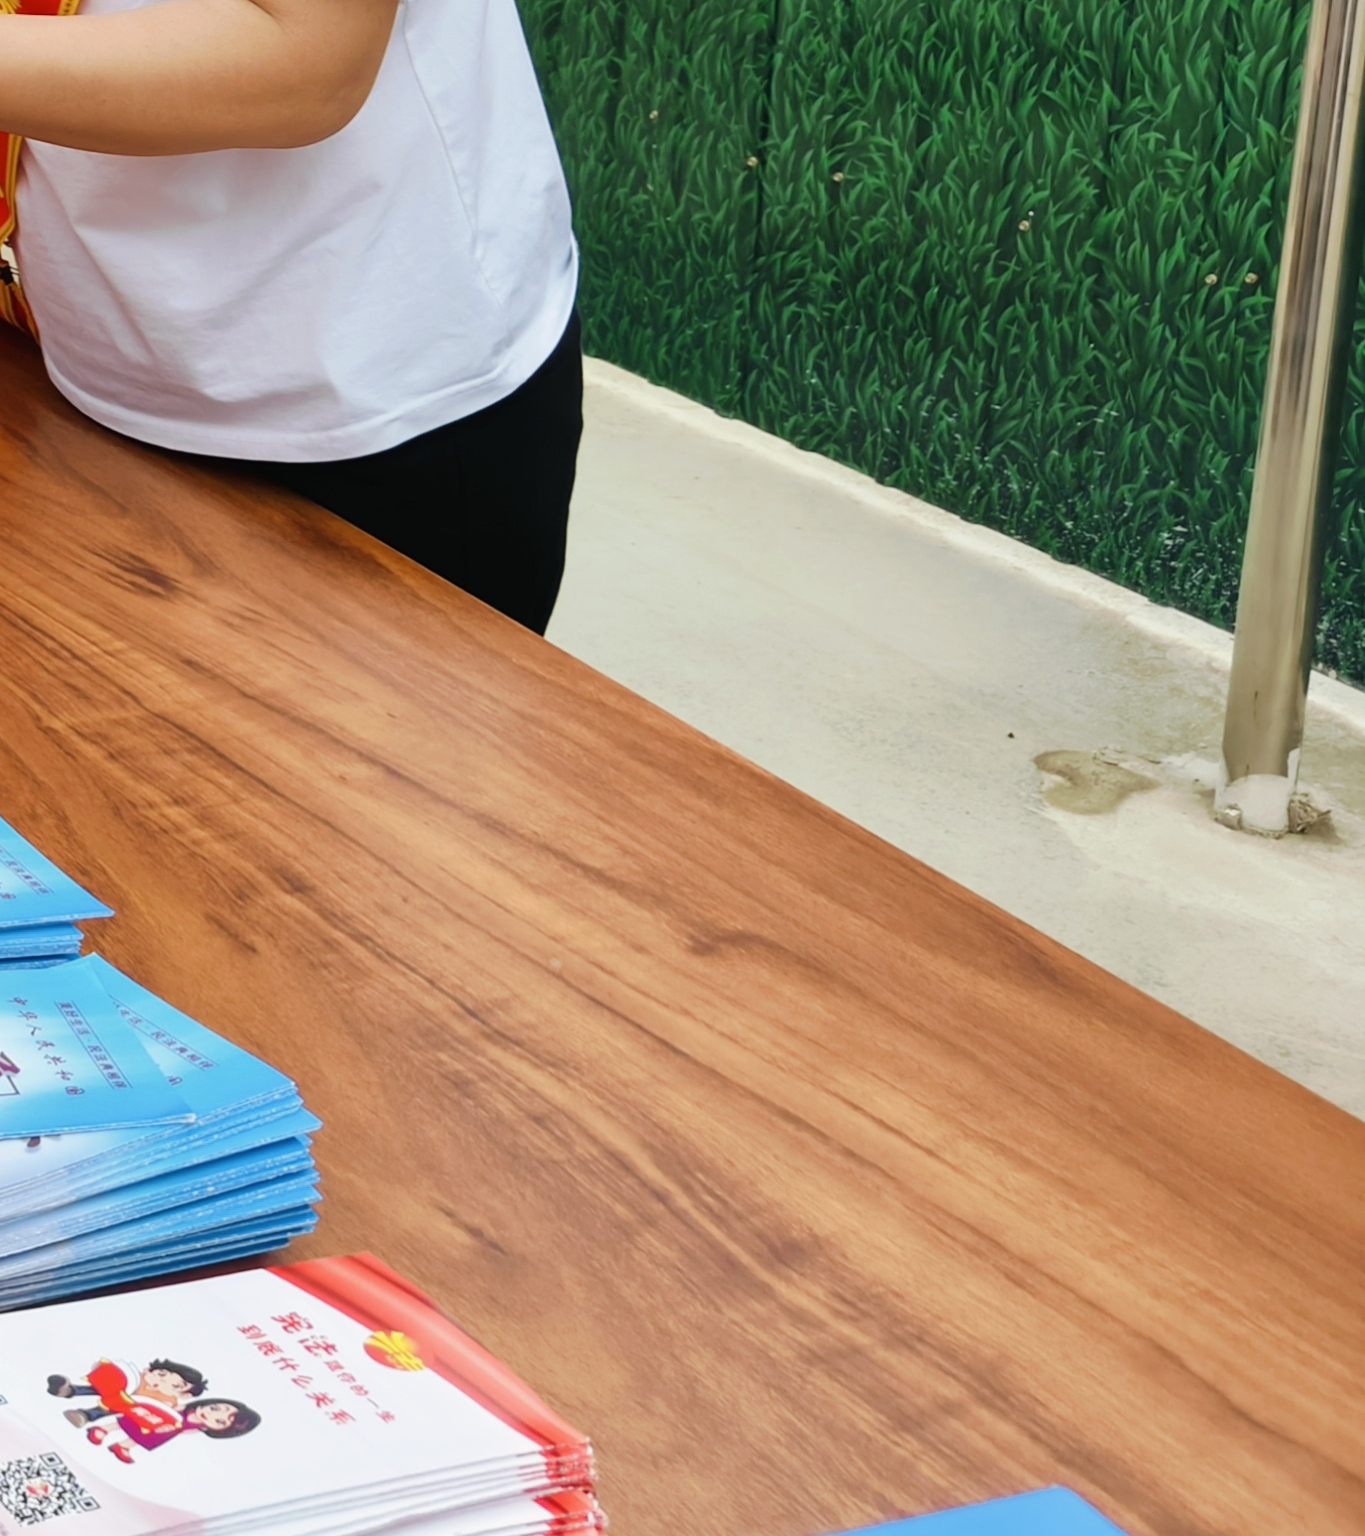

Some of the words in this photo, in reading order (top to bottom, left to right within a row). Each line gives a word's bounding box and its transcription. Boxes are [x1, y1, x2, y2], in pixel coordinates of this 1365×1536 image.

[8, 996, 86, 1096] 中华人民共和国
[236, 1323, 357, 1426] 到底什么关系
